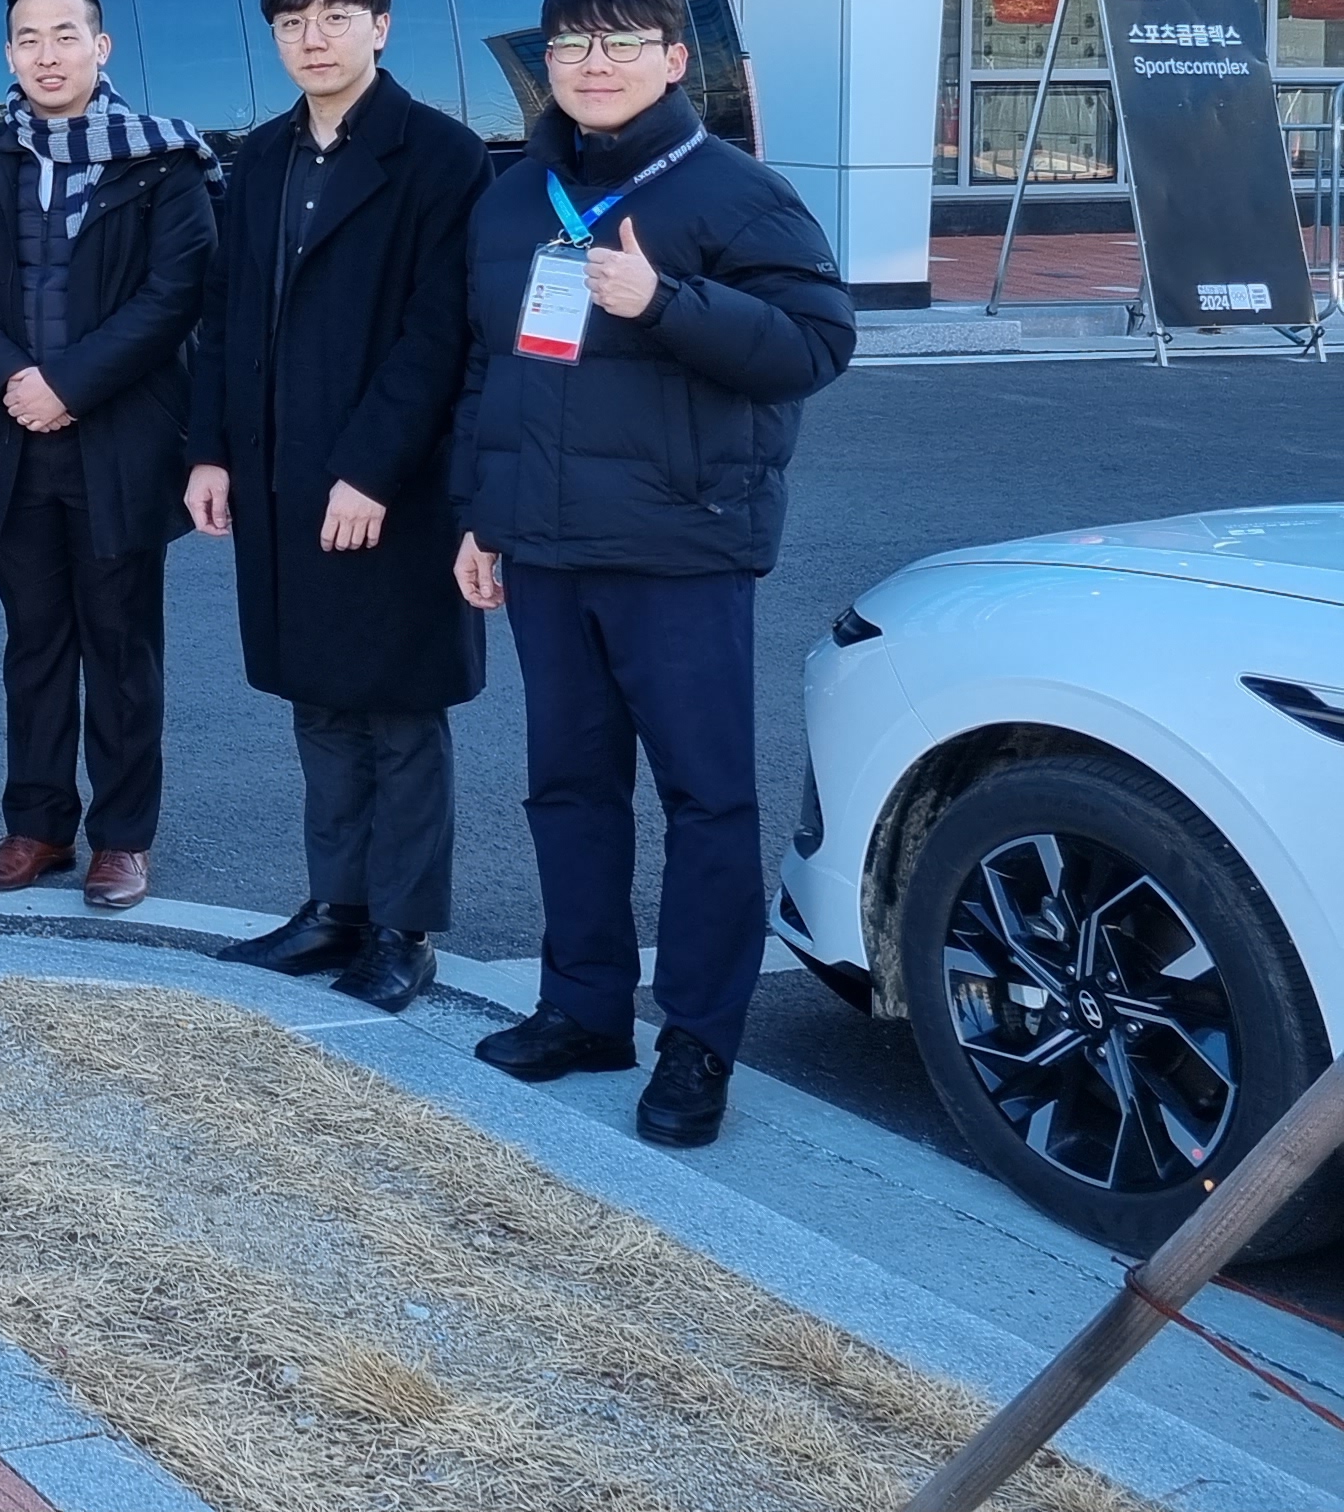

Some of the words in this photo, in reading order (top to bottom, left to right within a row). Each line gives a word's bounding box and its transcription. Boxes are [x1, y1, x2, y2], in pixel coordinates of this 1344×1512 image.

[1128, 23, 1243, 48] 스포츠콤플렉스
[1133, 55, 1250, 79] Sportscomplex
[633, 159, 667, 185] Galaxy
[1199, 294, 1231, 310] 2024
